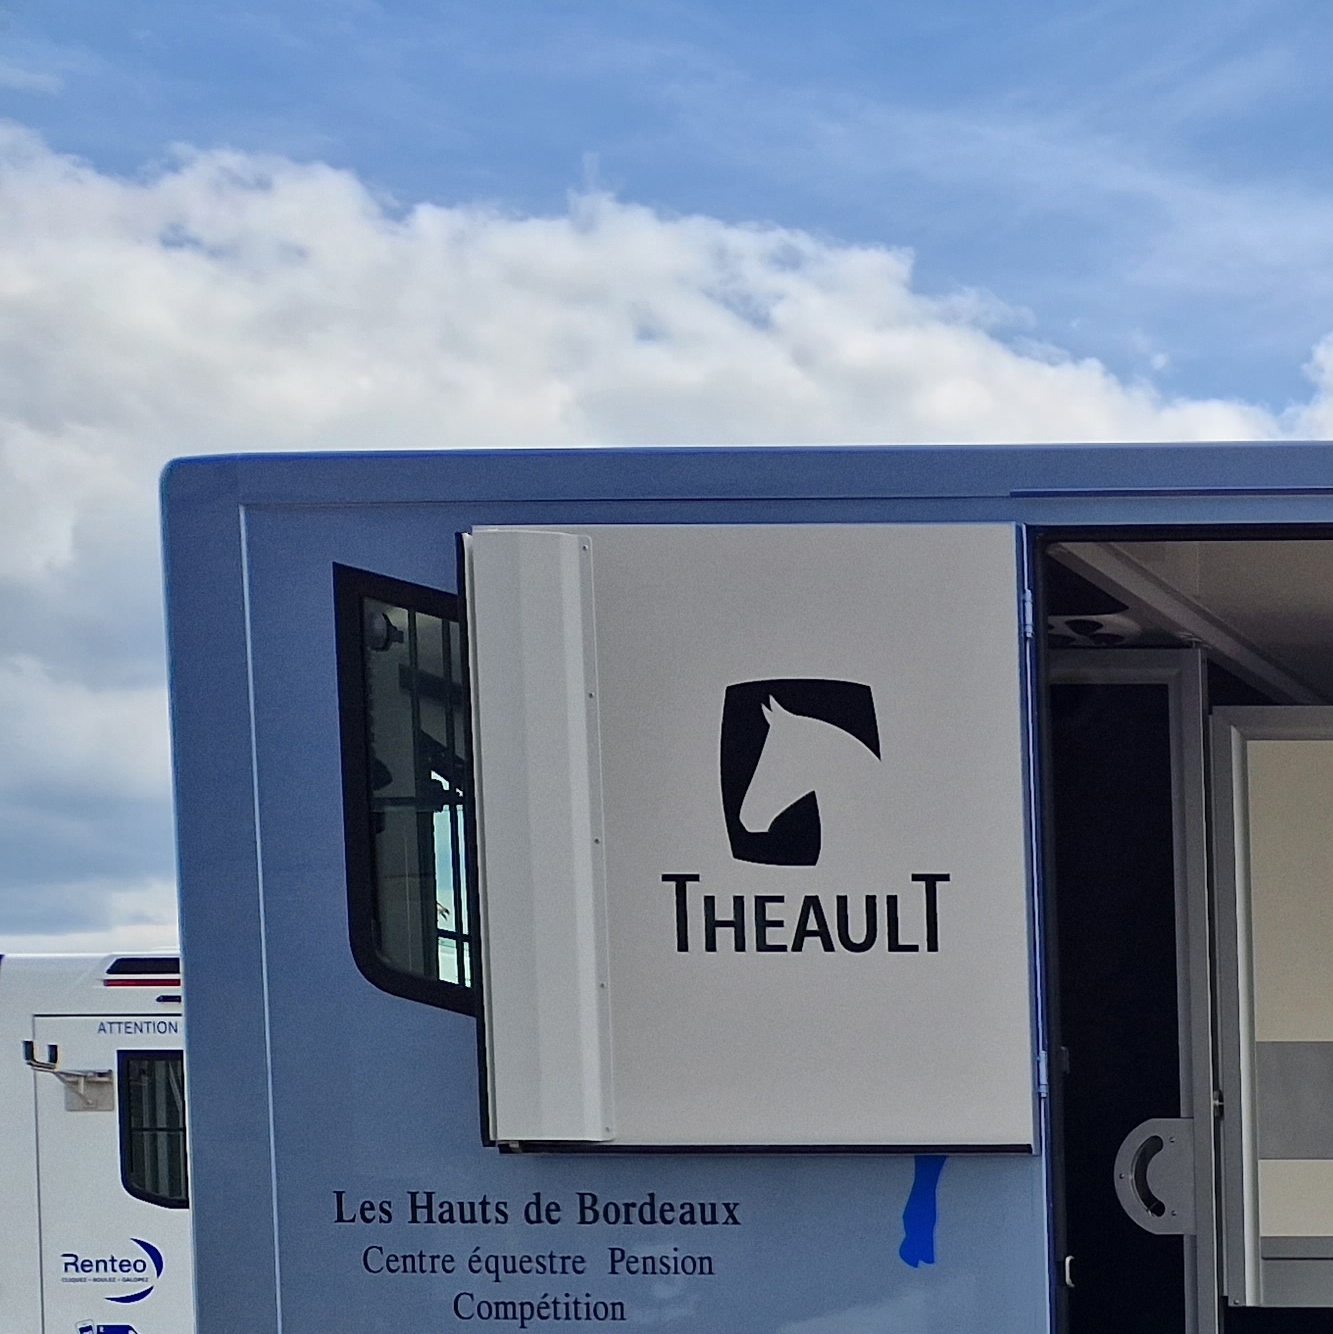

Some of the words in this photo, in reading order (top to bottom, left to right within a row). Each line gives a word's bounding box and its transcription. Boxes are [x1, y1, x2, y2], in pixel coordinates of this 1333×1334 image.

[661, 873, 951, 953] THEAULT
[97, 1020, 179, 1035] ATTENTION
[333, 1190, 394, 1225] Les
[406, 1191, 509, 1226] Hauts
[523, 1192, 562, 1226] de
[576, 1192, 742, 1226] Bordeaux
[60, 1253, 147, 1273] Renteo
[362, 1245, 456, 1275] Centre
[467, 1246, 587, 1283] équestre
[607, 1247, 715, 1276] Pension
[452, 1292, 627, 1329] Compétition
